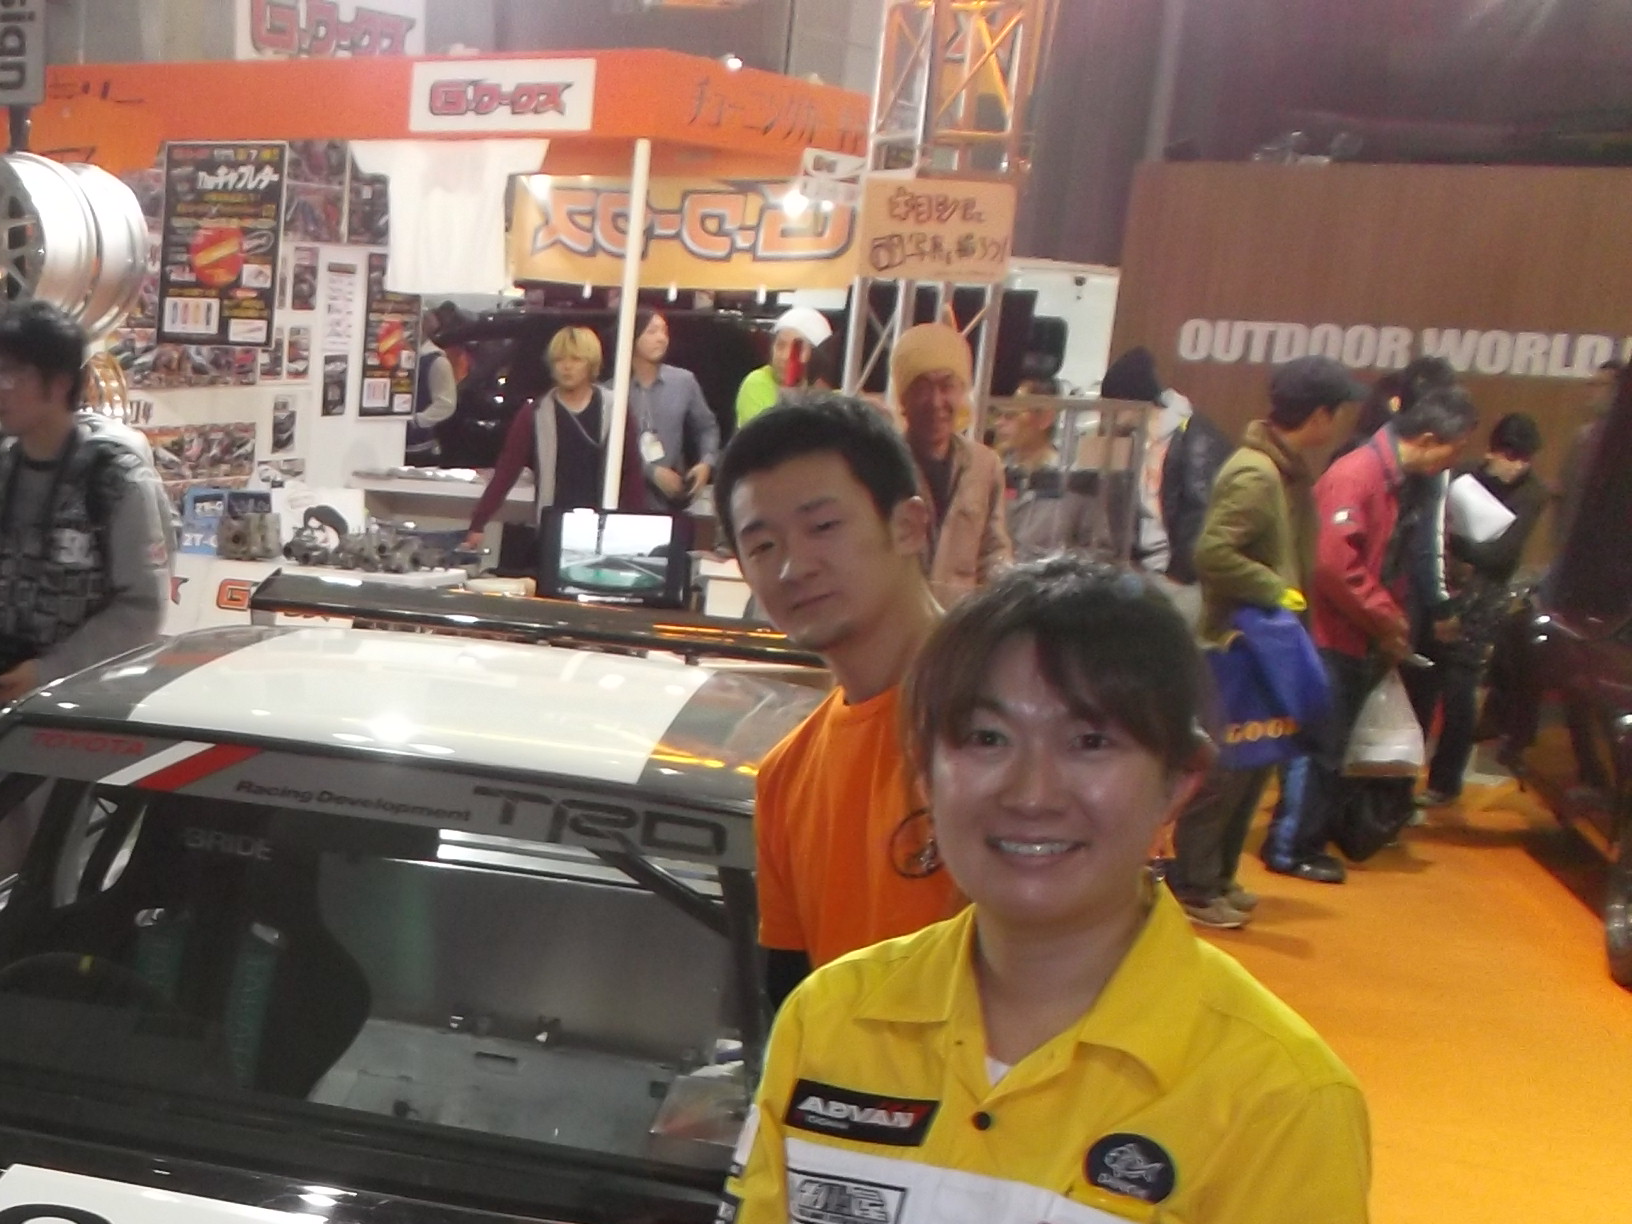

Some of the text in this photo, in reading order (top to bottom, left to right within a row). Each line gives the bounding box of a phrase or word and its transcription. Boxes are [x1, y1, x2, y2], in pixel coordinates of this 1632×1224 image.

[1177, 318, 1614, 379] OUTDOOR WORLD
[29, 729, 148, 758] TOYOTA
[236, 780, 472, 823] Racing Development
[473, 785, 727, 857] TRD
[182, 826, 274, 862] BRIDE
[796, 1095, 917, 1129] ADVAN
